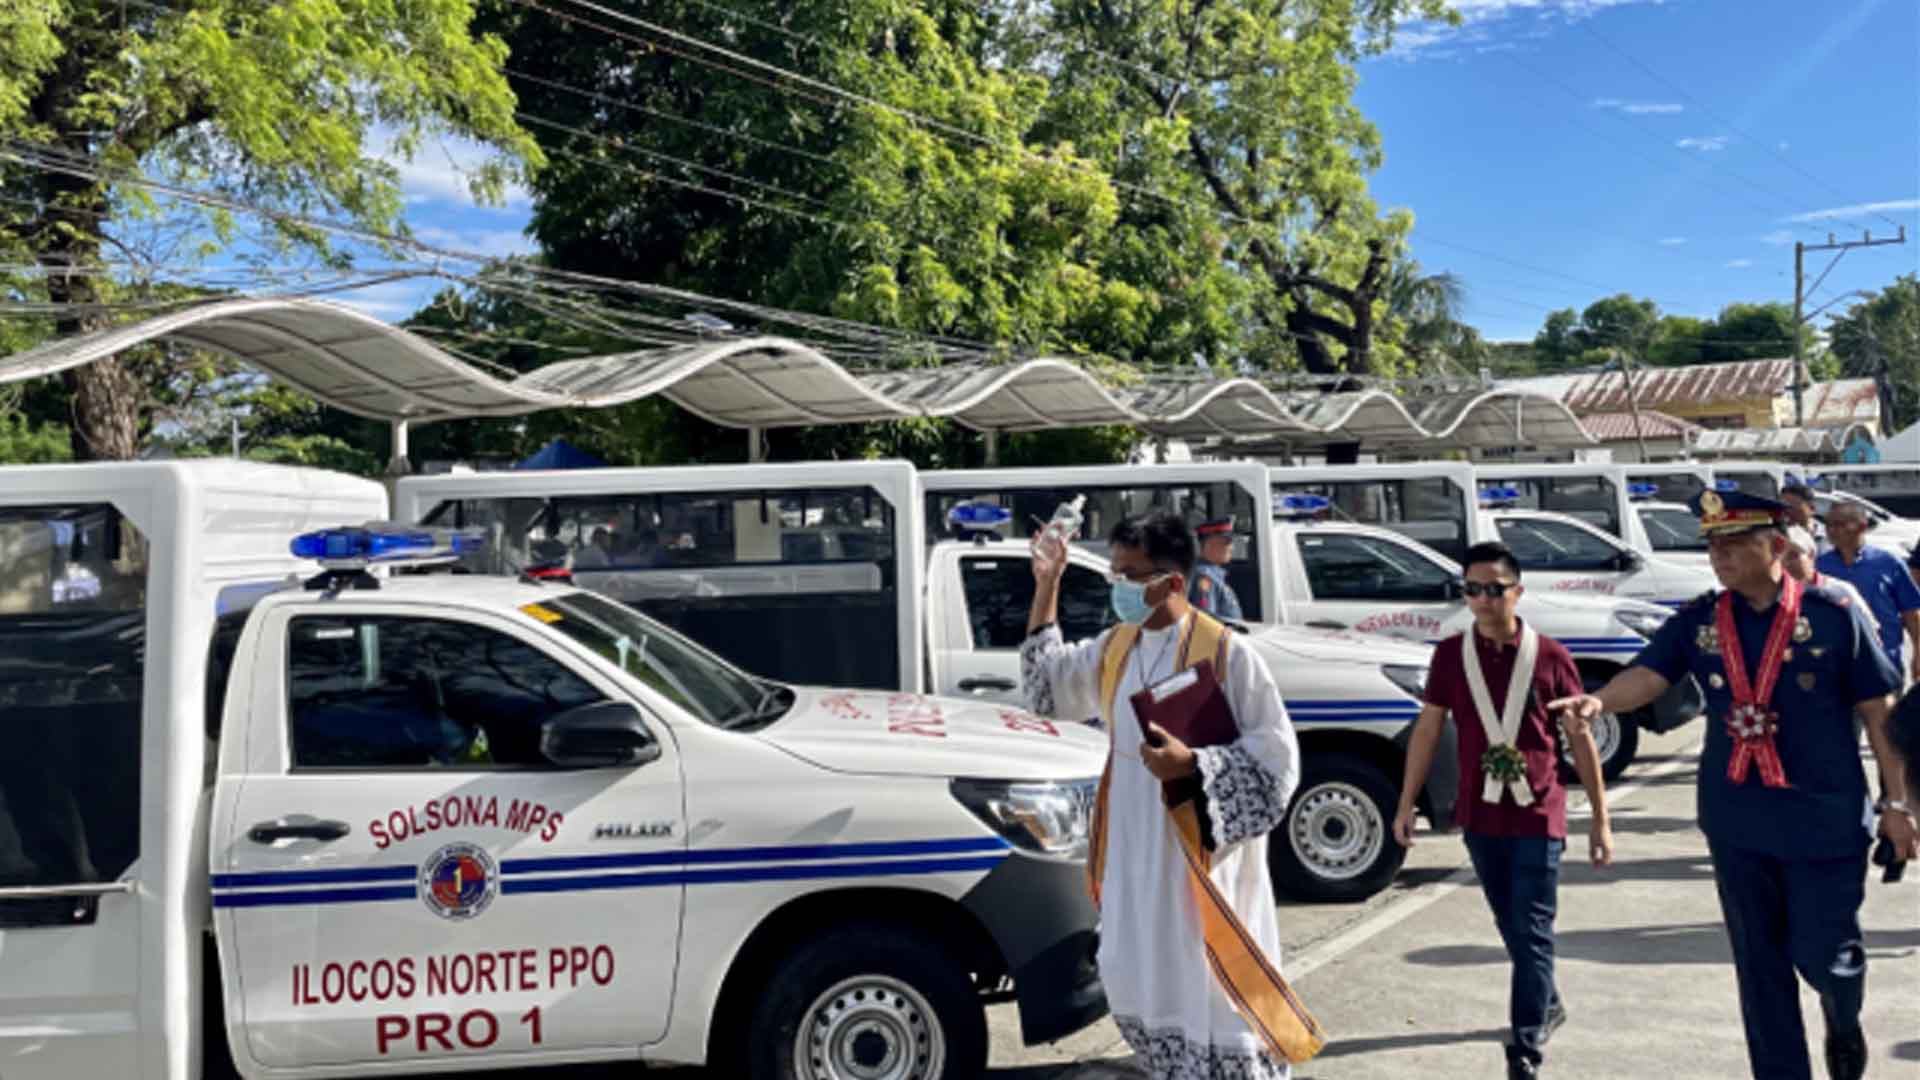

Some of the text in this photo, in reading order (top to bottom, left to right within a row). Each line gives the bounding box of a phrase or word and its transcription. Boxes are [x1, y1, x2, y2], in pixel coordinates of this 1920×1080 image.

[369, 795, 564, 849] SOLSONA MPS
[292, 944, 615, 1005] ILOCOS NORTE PPO
[375, 1005, 543, 1054] PRO 1
